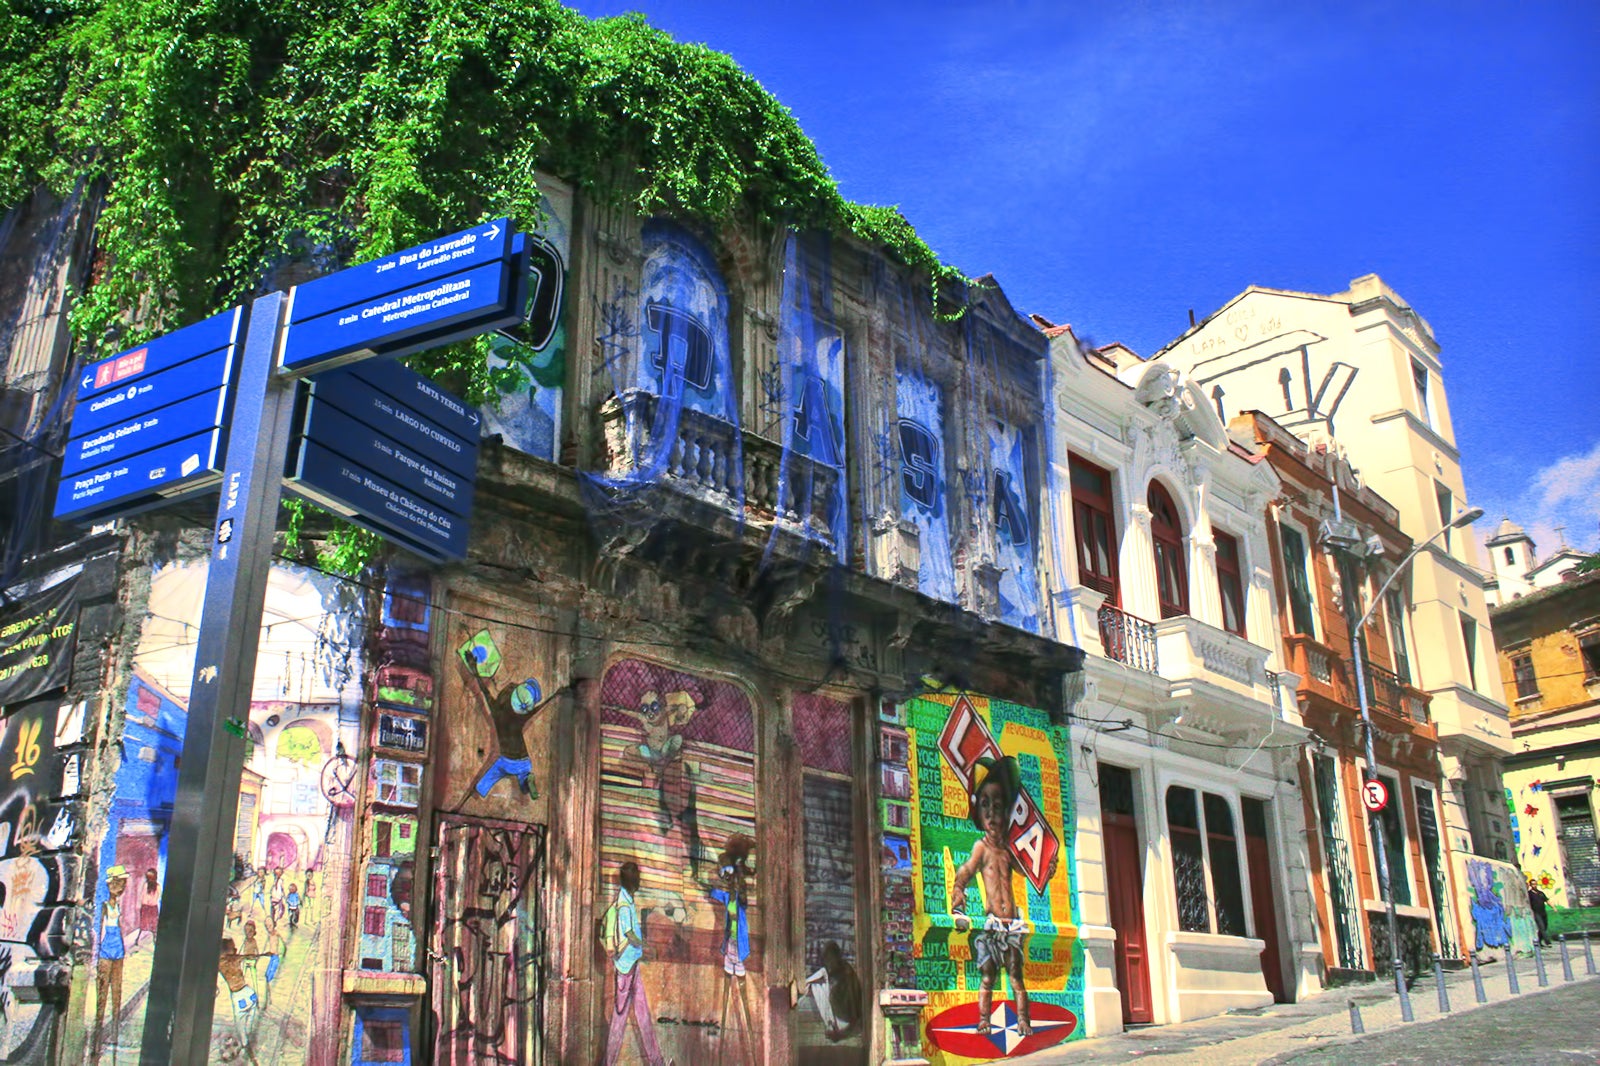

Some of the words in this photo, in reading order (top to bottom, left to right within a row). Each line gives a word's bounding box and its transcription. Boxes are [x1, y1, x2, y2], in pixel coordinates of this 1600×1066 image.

[399, 252, 418, 266] Rua
[419, 246, 432, 259] do
[433, 233, 477, 255] Lavradio
[417, 252, 451, 270] Lavradio
[451, 245, 475, 260] Street
[361, 298, 401, 319] Catedral
[401, 278, 471, 307] Metropolitana
[382, 303, 431, 324] Metropolitan
[431, 290, 470, 309] Cathedral
[416, 381, 440, 401] SANTA
[440, 395, 465, 416] TERESA
[395, 409, 420, 430] LARGO
[420, 423, 431, 436] DO
[430, 430, 461, 453] CURVELO
[395, 450, 420, 470] Parque
[420, 464, 433, 477] das
[74, 476, 96, 490] Praça
[94, 471, 112, 484] Paris
[226, 471, 240, 510] LAPA
[442, 487, 455, 500] Park
[363, 477, 389, 498] Museu
[389, 491, 399, 503] da
[399, 496, 428, 518] Chácara
[428, 510, 438, 522] do
[438, 516, 451, 530] Céu
[408, 512, 417, 522] do
[427, 522, 450, 539] Museum
[14, 717, 42, 768] 16
[917, 748, 940, 768] YOGA
[1017, 752, 1040, 772] BIRA
[918, 767, 941, 784] ARTE
[919, 782, 942, 800] JESUS
[920, 798, 944, 815] CRISTO
[943, 800, 968, 818] FLOW
[920, 813, 943, 829] CASA
[943, 817, 955, 831] DA
[922, 850, 945, 867] ROCK
[923, 866, 945, 884] BIKE
[924, 898, 946, 914] VINIL
[923, 942, 949, 958] LUTA
[949, 944, 971, 960] AMOR
[1028, 947, 1052, 962] SKATE
[914, 960, 957, 977] NATUREZA
[915, 976, 956, 991] ROOTS
